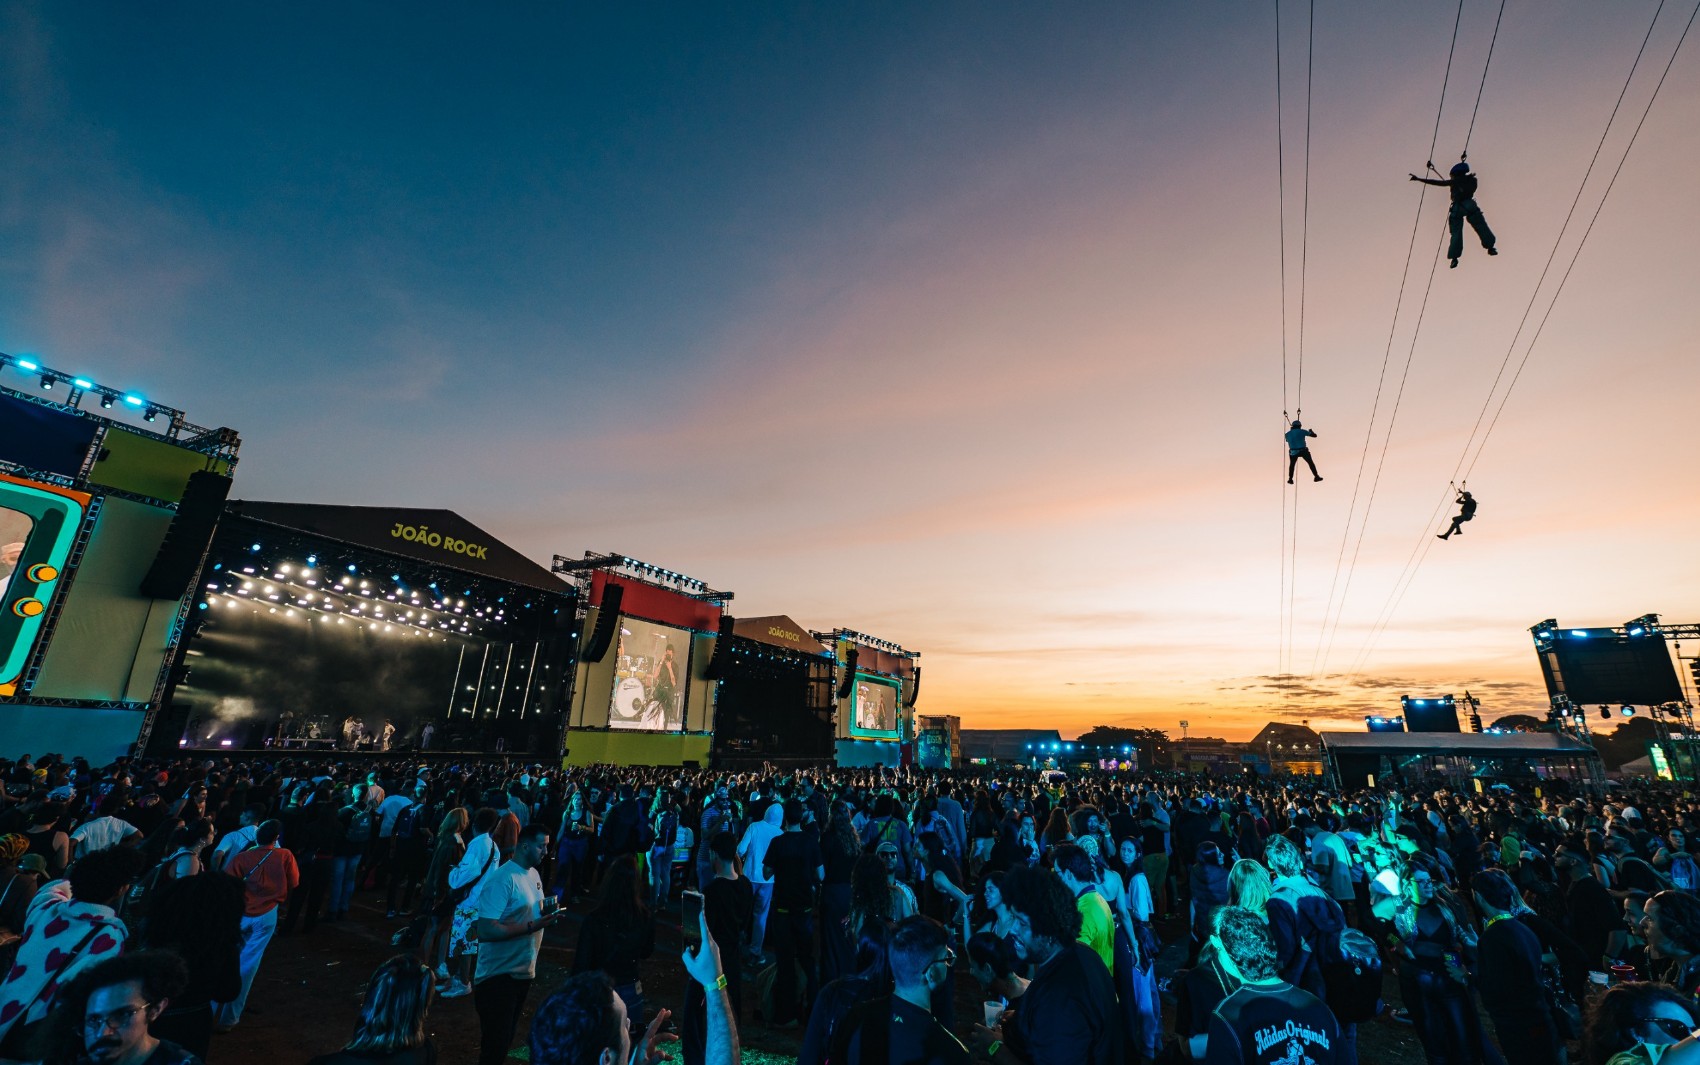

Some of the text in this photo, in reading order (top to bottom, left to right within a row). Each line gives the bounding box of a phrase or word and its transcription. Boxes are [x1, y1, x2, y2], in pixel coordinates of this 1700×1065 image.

[391, 522, 488, 560] JOÃO ROCK
[768, 626, 800, 642] JOÃO ROCK
[1254, 1019, 1330, 1056] Adidas Originals
